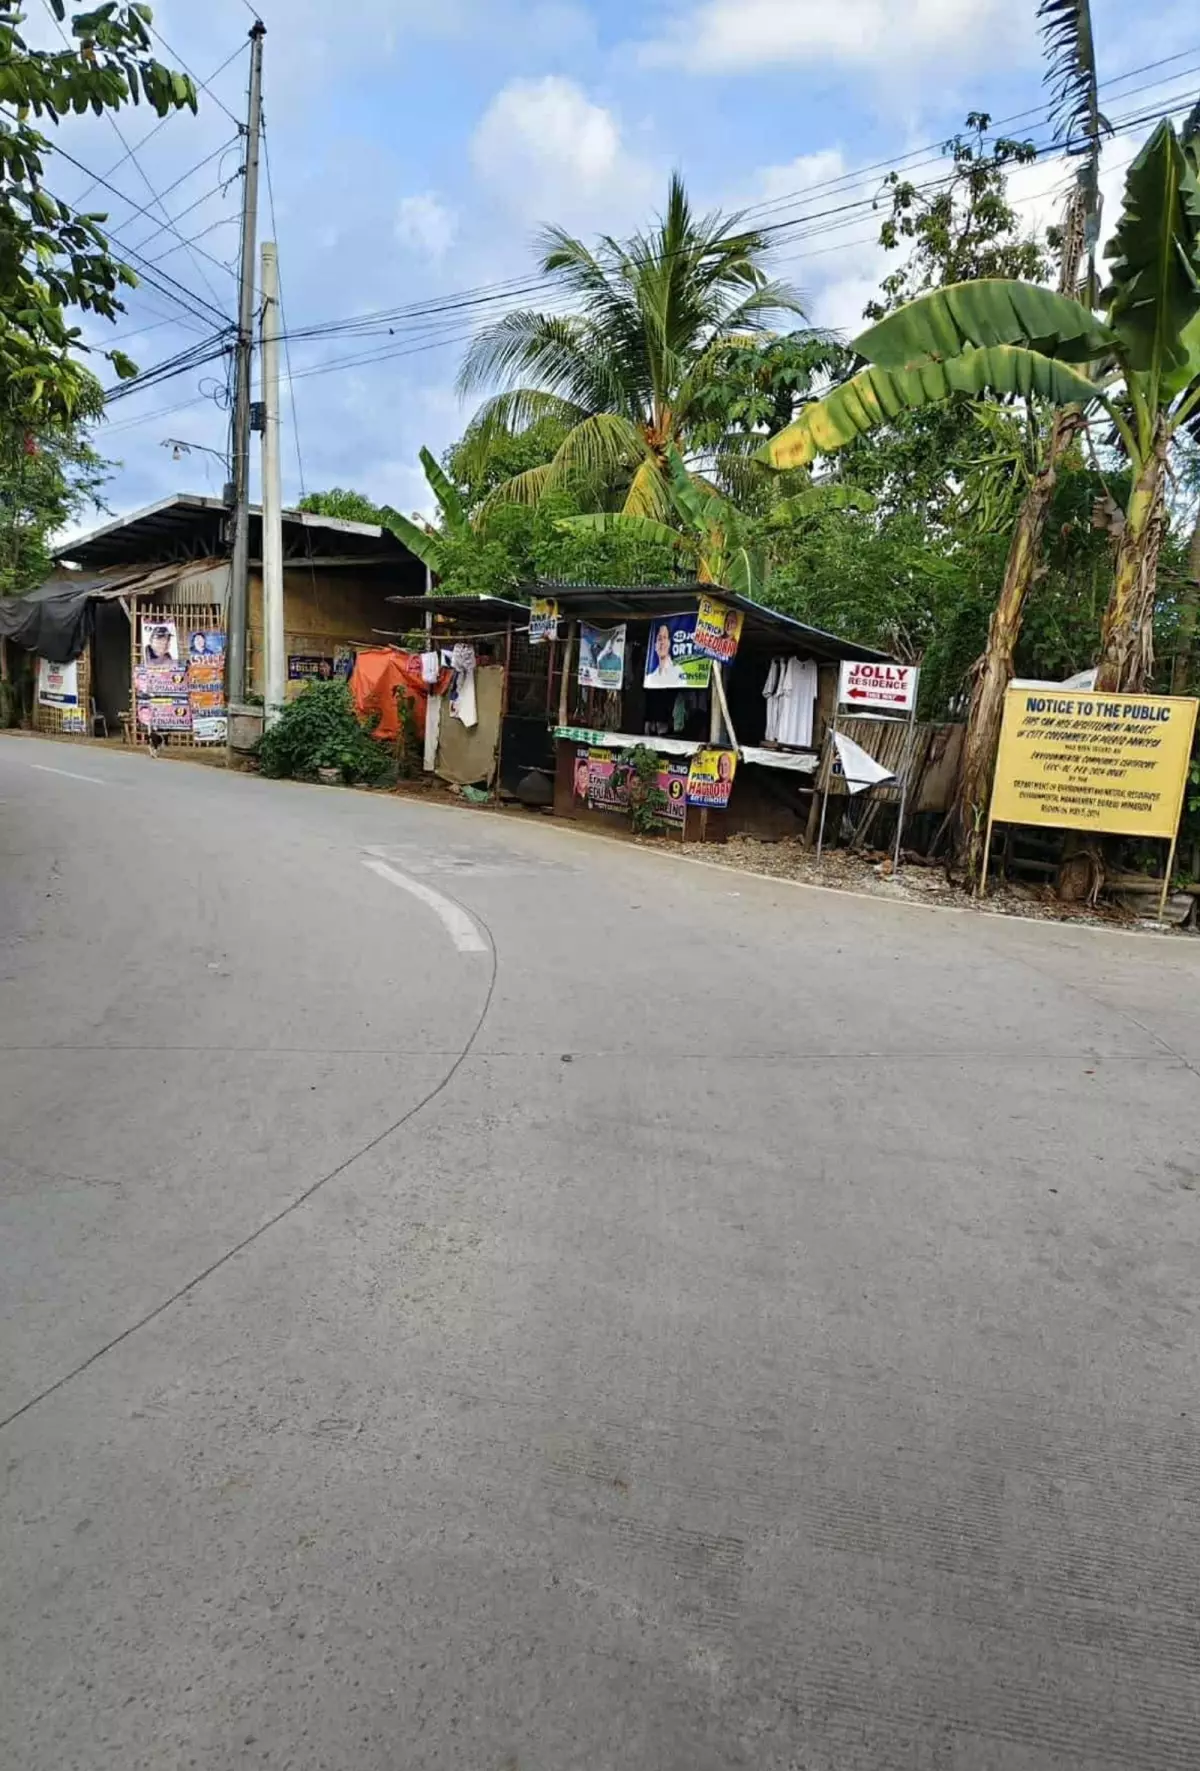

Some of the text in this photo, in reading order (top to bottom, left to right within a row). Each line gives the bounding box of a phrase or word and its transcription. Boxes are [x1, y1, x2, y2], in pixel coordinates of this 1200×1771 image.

[849, 664, 908, 681] JOLLY
[848, 677, 908, 690] RESIDENCE
[1026, 698, 1171, 722] NOTICE TO THE PUBLIC
[672, 780, 682, 799] 9
